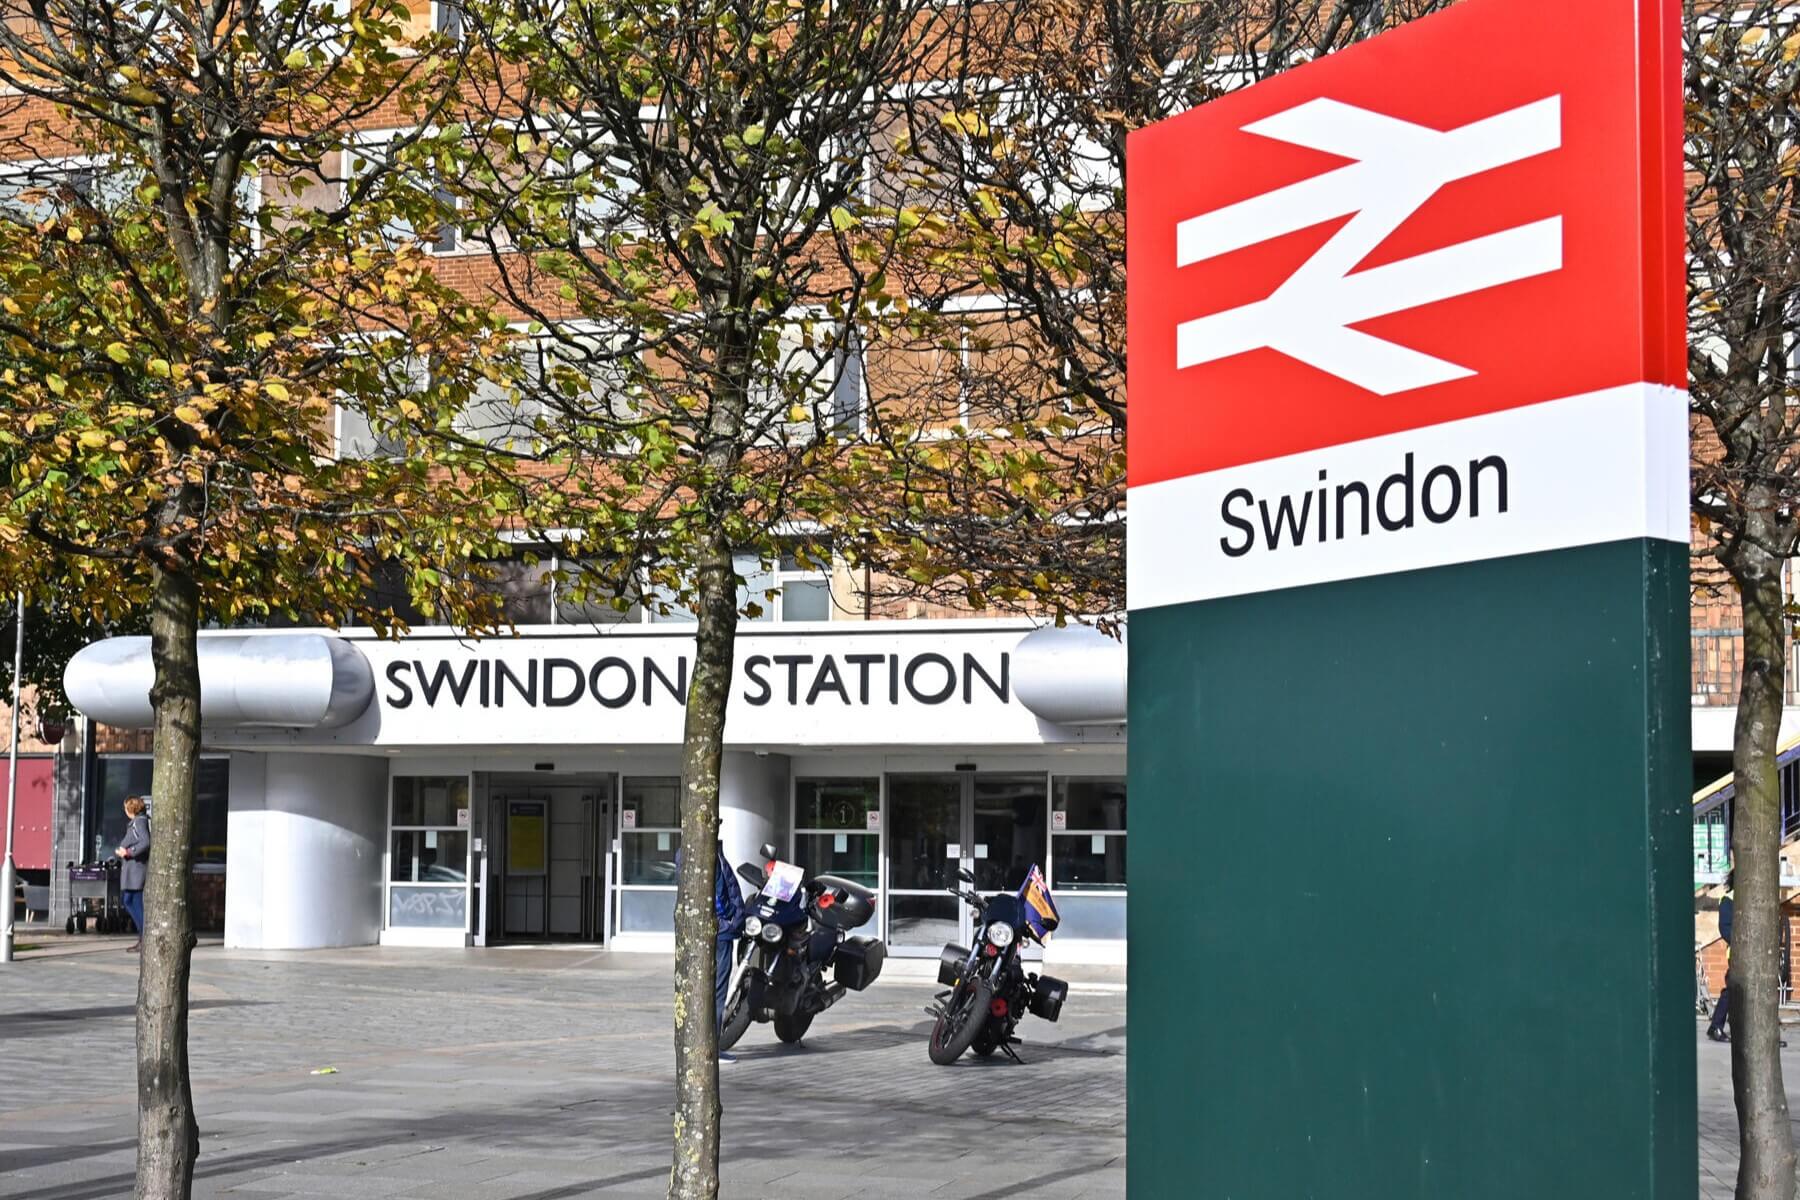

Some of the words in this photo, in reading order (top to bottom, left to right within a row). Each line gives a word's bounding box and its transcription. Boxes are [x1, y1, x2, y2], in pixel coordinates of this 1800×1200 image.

[1220, 451, 1508, 558] Swindon
[385, 656, 687, 709] SWINDON
[743, 652, 1010, 706] STATION
